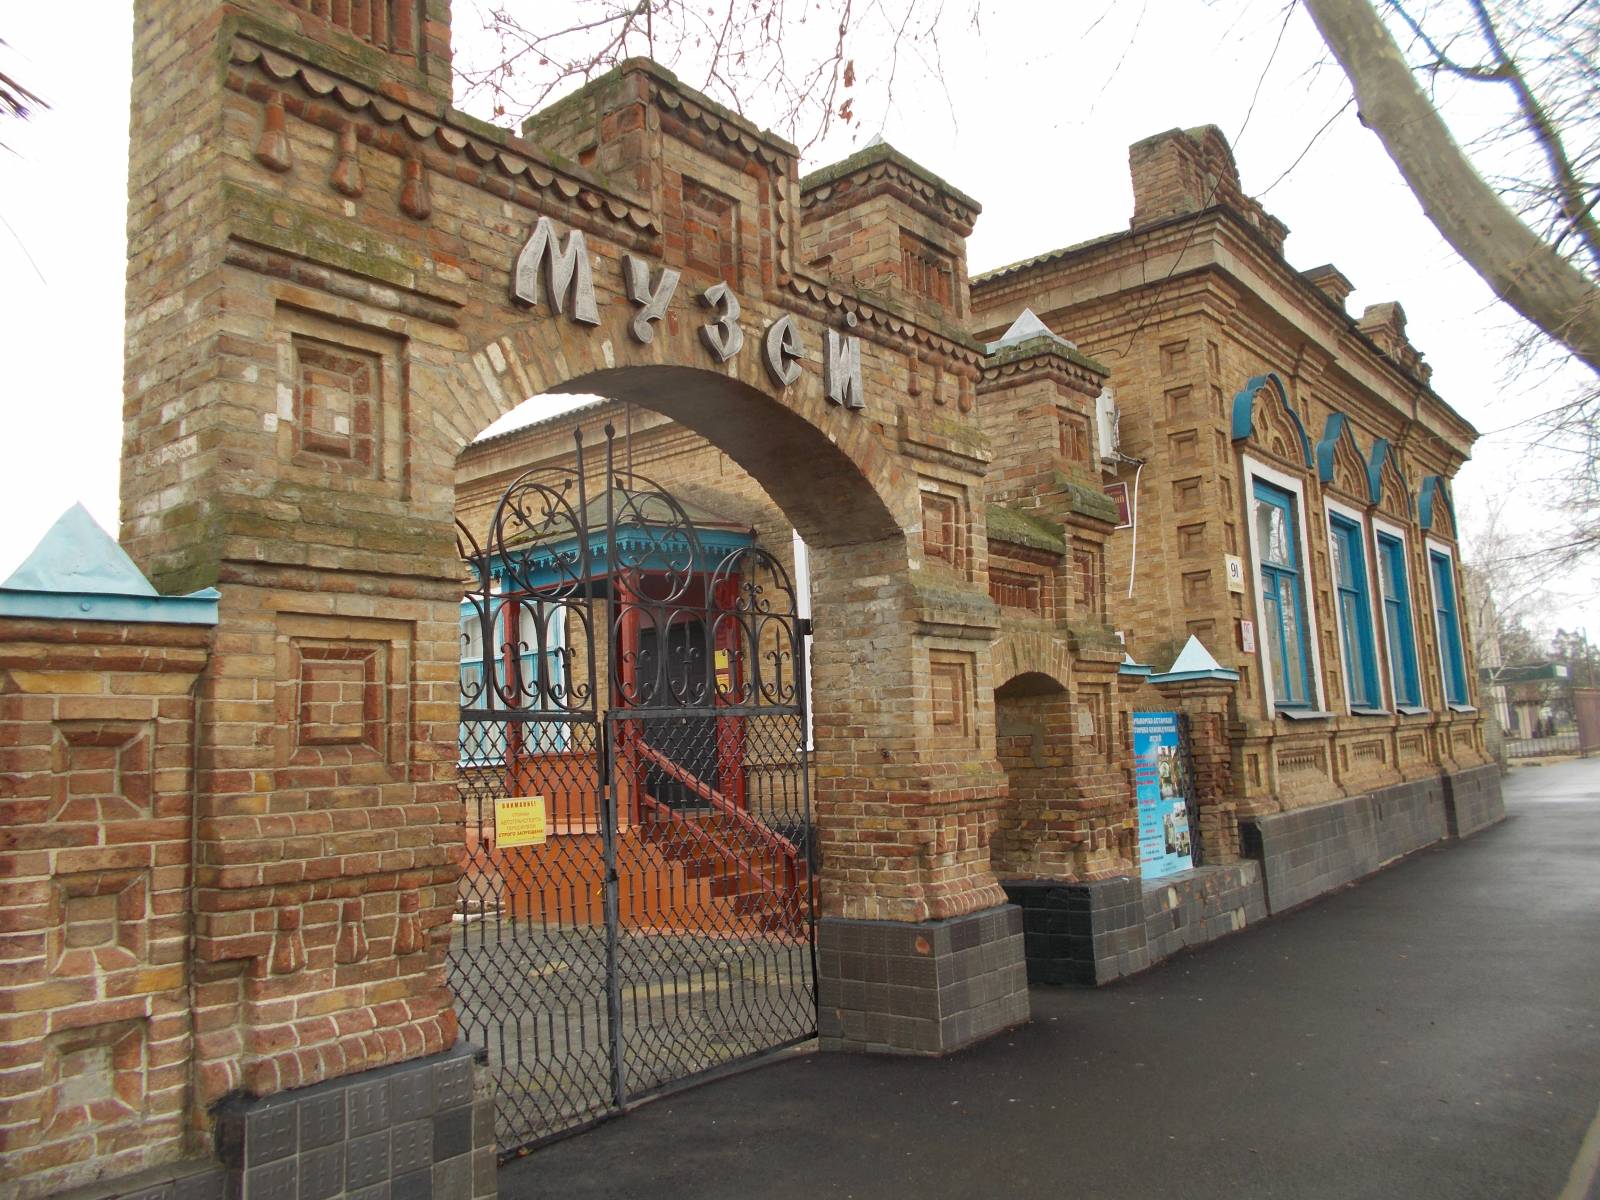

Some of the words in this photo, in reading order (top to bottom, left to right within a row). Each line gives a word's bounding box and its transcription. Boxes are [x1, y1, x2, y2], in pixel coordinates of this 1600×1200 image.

[510, 216, 865, 410] МУЗЕЙ
[1231, 562, 1239, 577] 91
[501, 800, 536, 808] ВНИМАНИЕ!
